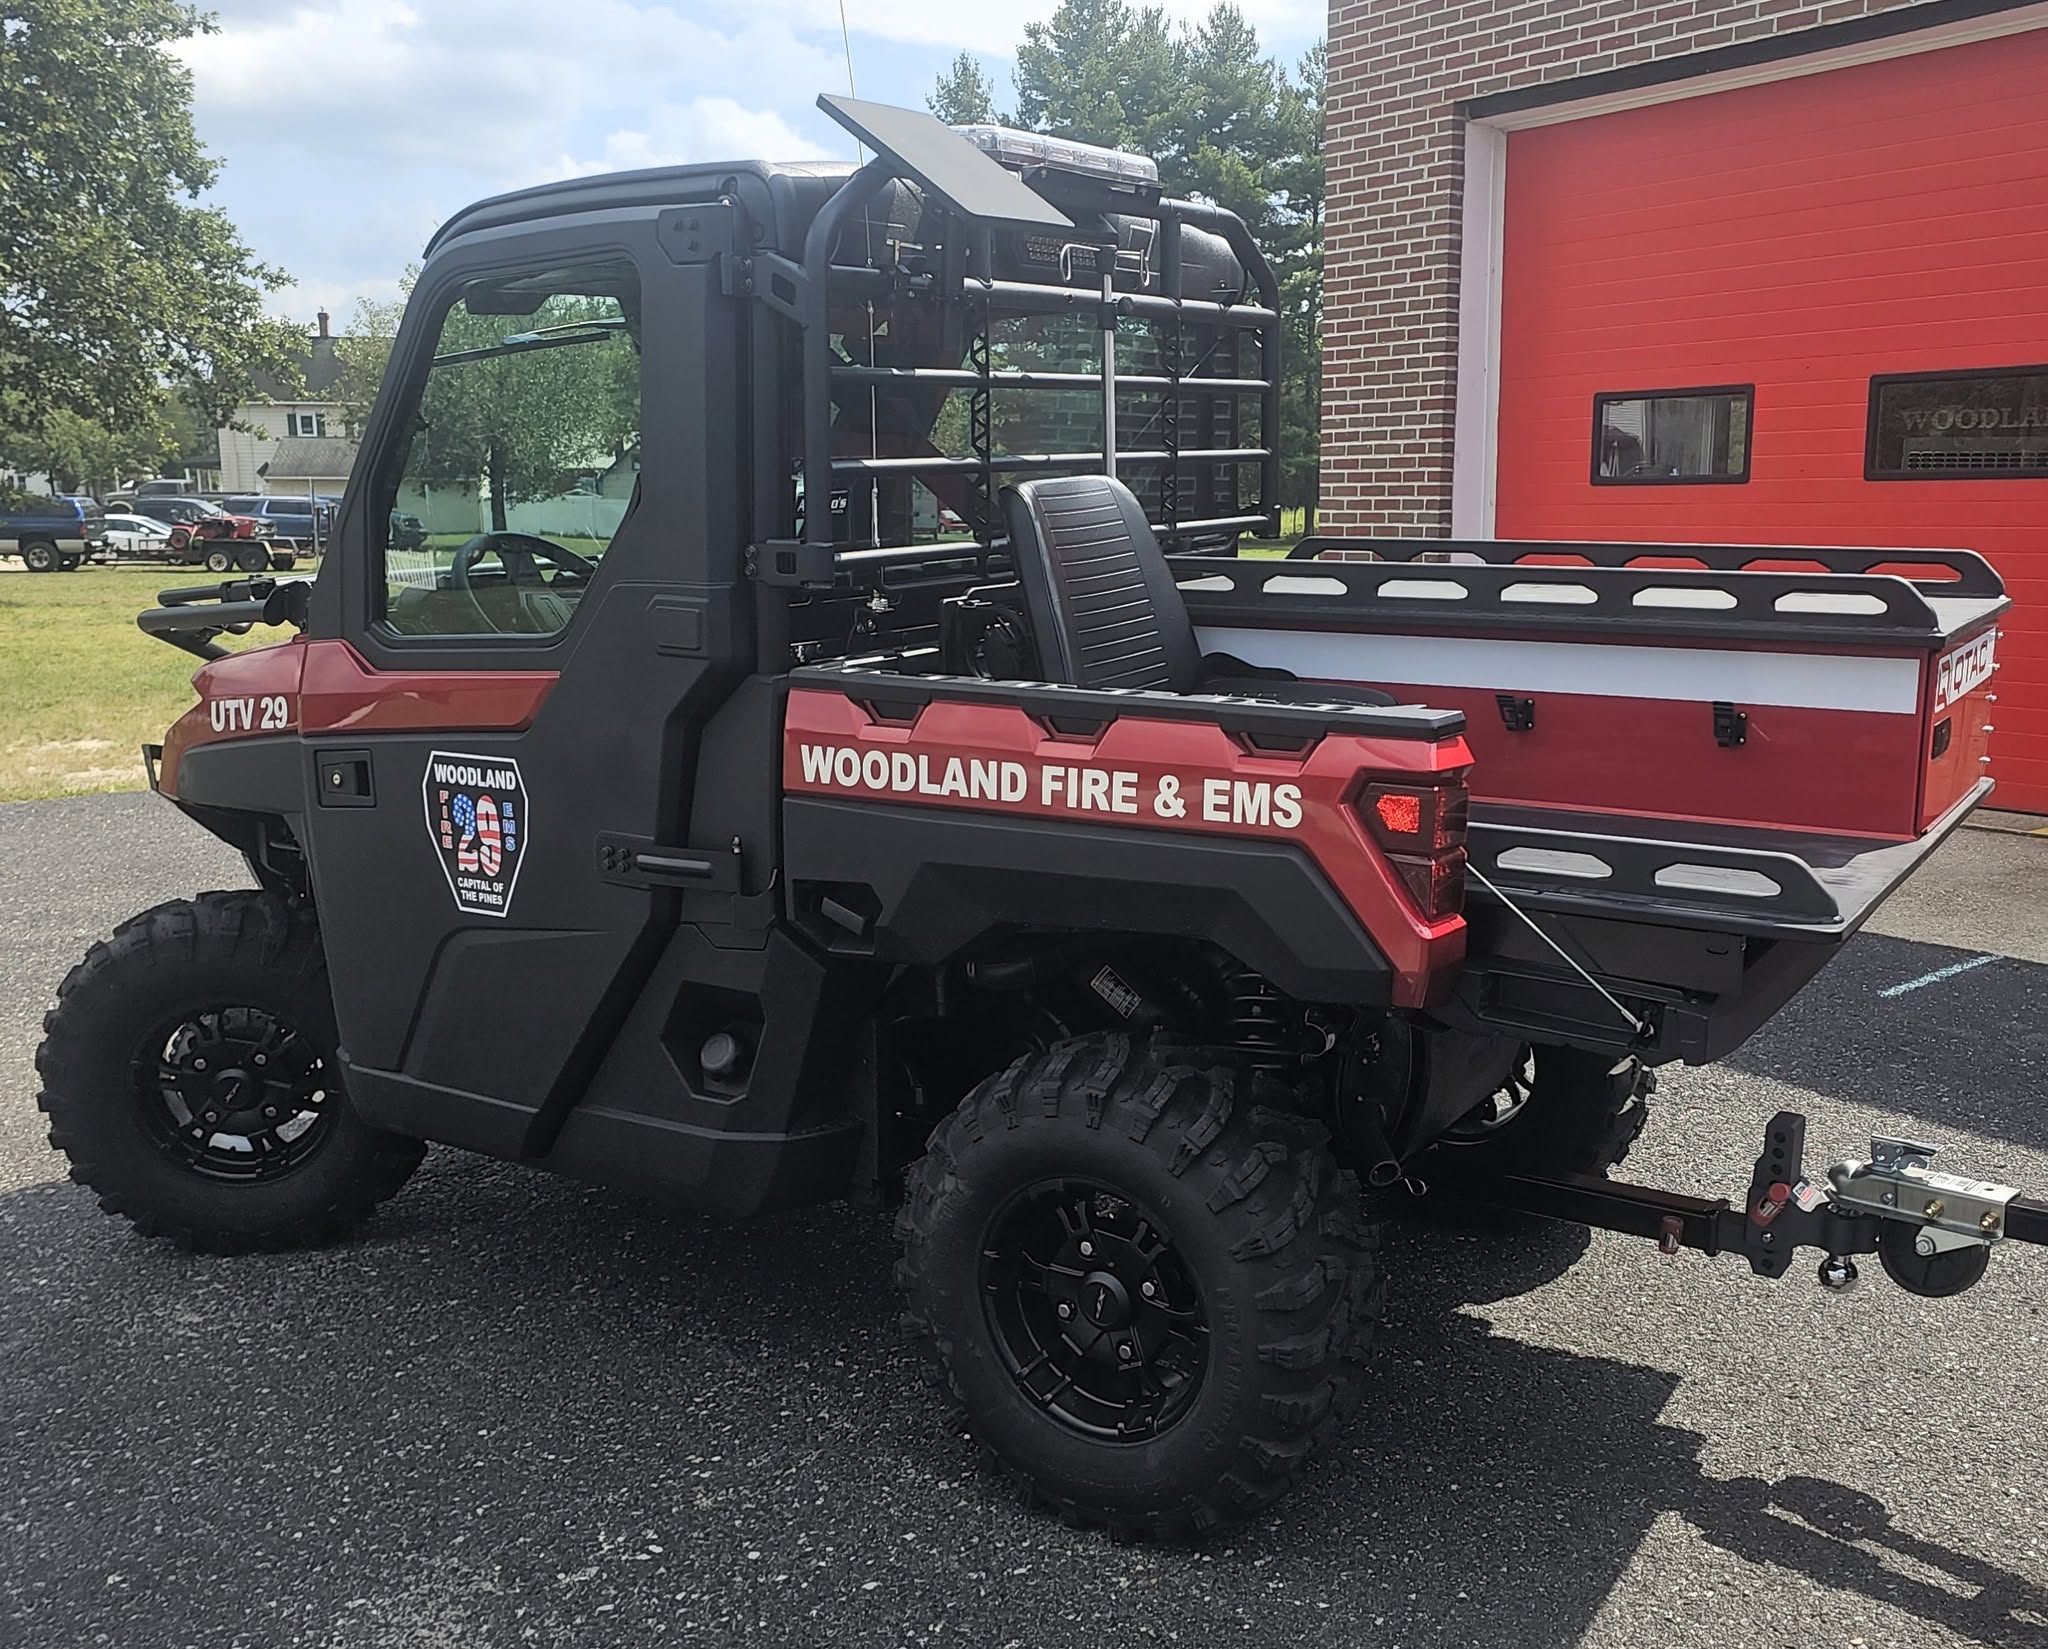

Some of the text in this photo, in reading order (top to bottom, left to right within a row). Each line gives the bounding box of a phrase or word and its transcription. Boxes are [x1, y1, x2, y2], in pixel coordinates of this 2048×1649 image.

[1899, 406, 2048, 431] WOODLA
[1953, 639, 1988, 694] QTAC
[210, 696, 288, 732] UTV 29
[433, 763, 517, 791] WOODLAND
[800, 744, 1303, 829] WOODLAND FIRE & EMS
[439, 789, 454, 850] FIRE
[452, 793, 502, 877] 29
[502, 802, 516, 852] EMS
[457, 877, 504, 893] CAPITAL OF
[460, 889, 503, 906] THE PINES
